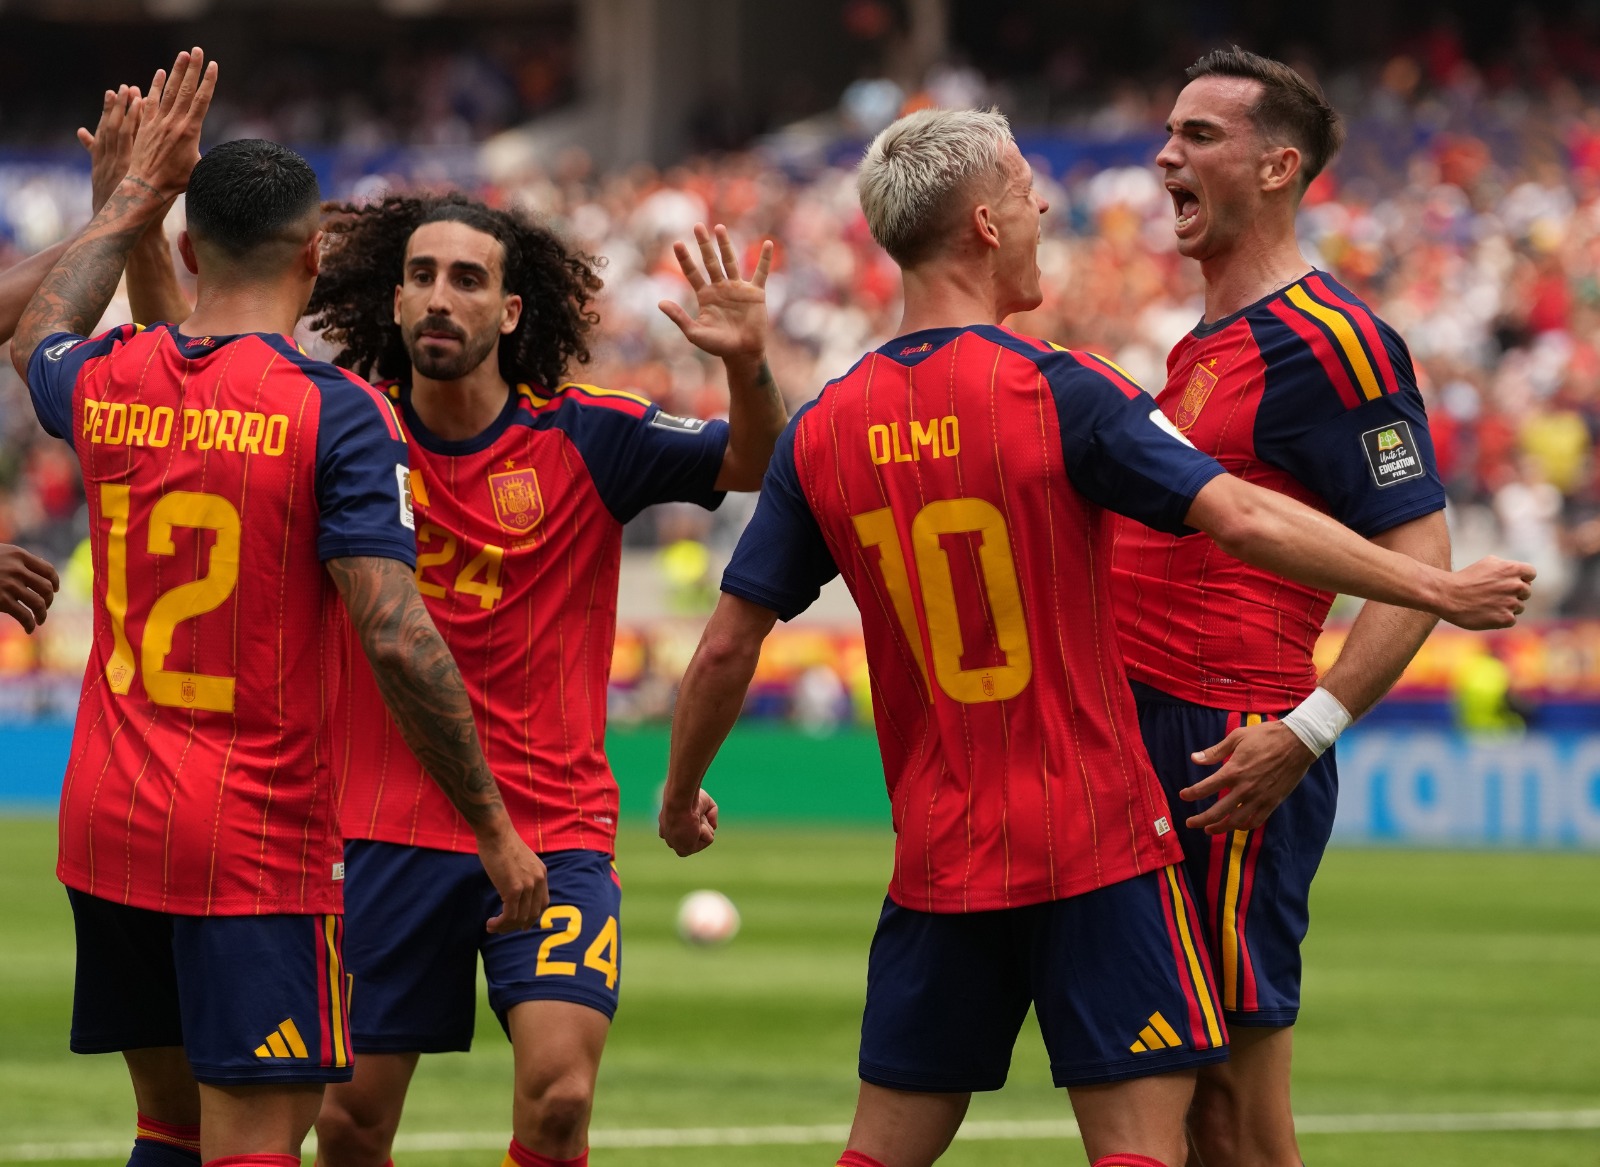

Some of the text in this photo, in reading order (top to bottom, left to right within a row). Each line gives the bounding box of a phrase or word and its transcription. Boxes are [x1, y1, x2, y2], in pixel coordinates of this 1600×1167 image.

[900, 342, 933, 357] España
[82, 398, 289, 456] PEDRO PORRO
[868, 415, 961, 465] OLMO
[1379, 446, 1407, 463] Unite For
[1379, 456, 1415, 475] EDUCATION
[416, 523, 504, 610] 24
[100, 483, 241, 713] 12
[852, 497, 1032, 705] 10
[535, 905, 618, 990] 24
